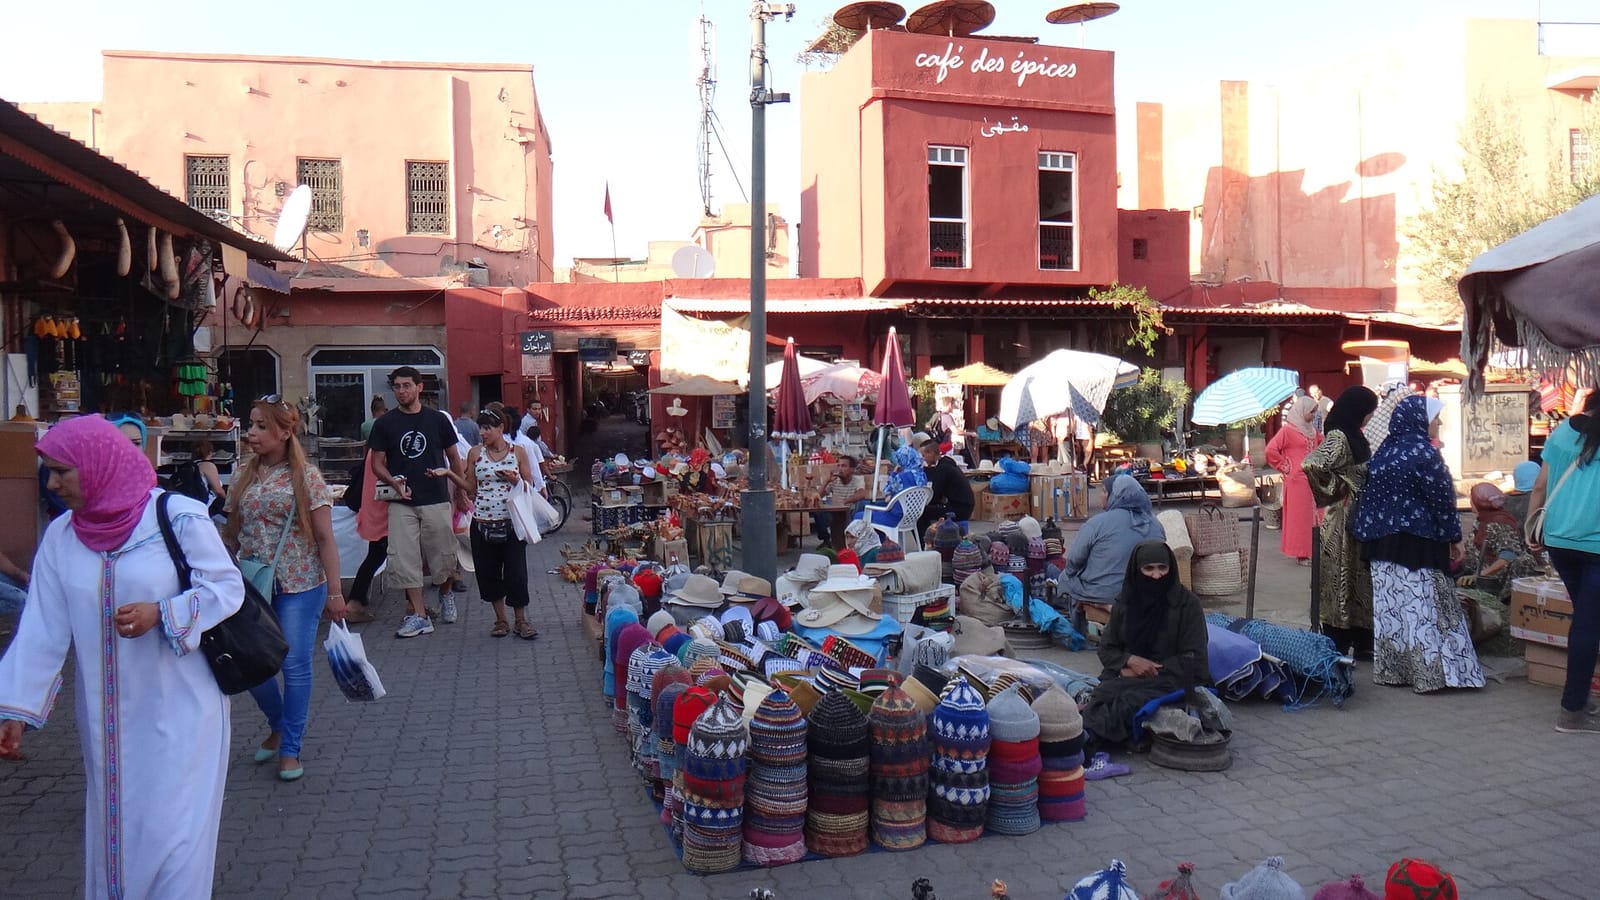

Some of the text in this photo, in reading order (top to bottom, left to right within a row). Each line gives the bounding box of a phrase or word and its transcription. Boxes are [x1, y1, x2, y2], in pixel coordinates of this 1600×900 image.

[915, 42, 1078, 88] café des épices
[527, 332, 546, 342] حارس
[523, 342, 552, 353] الدراجات
